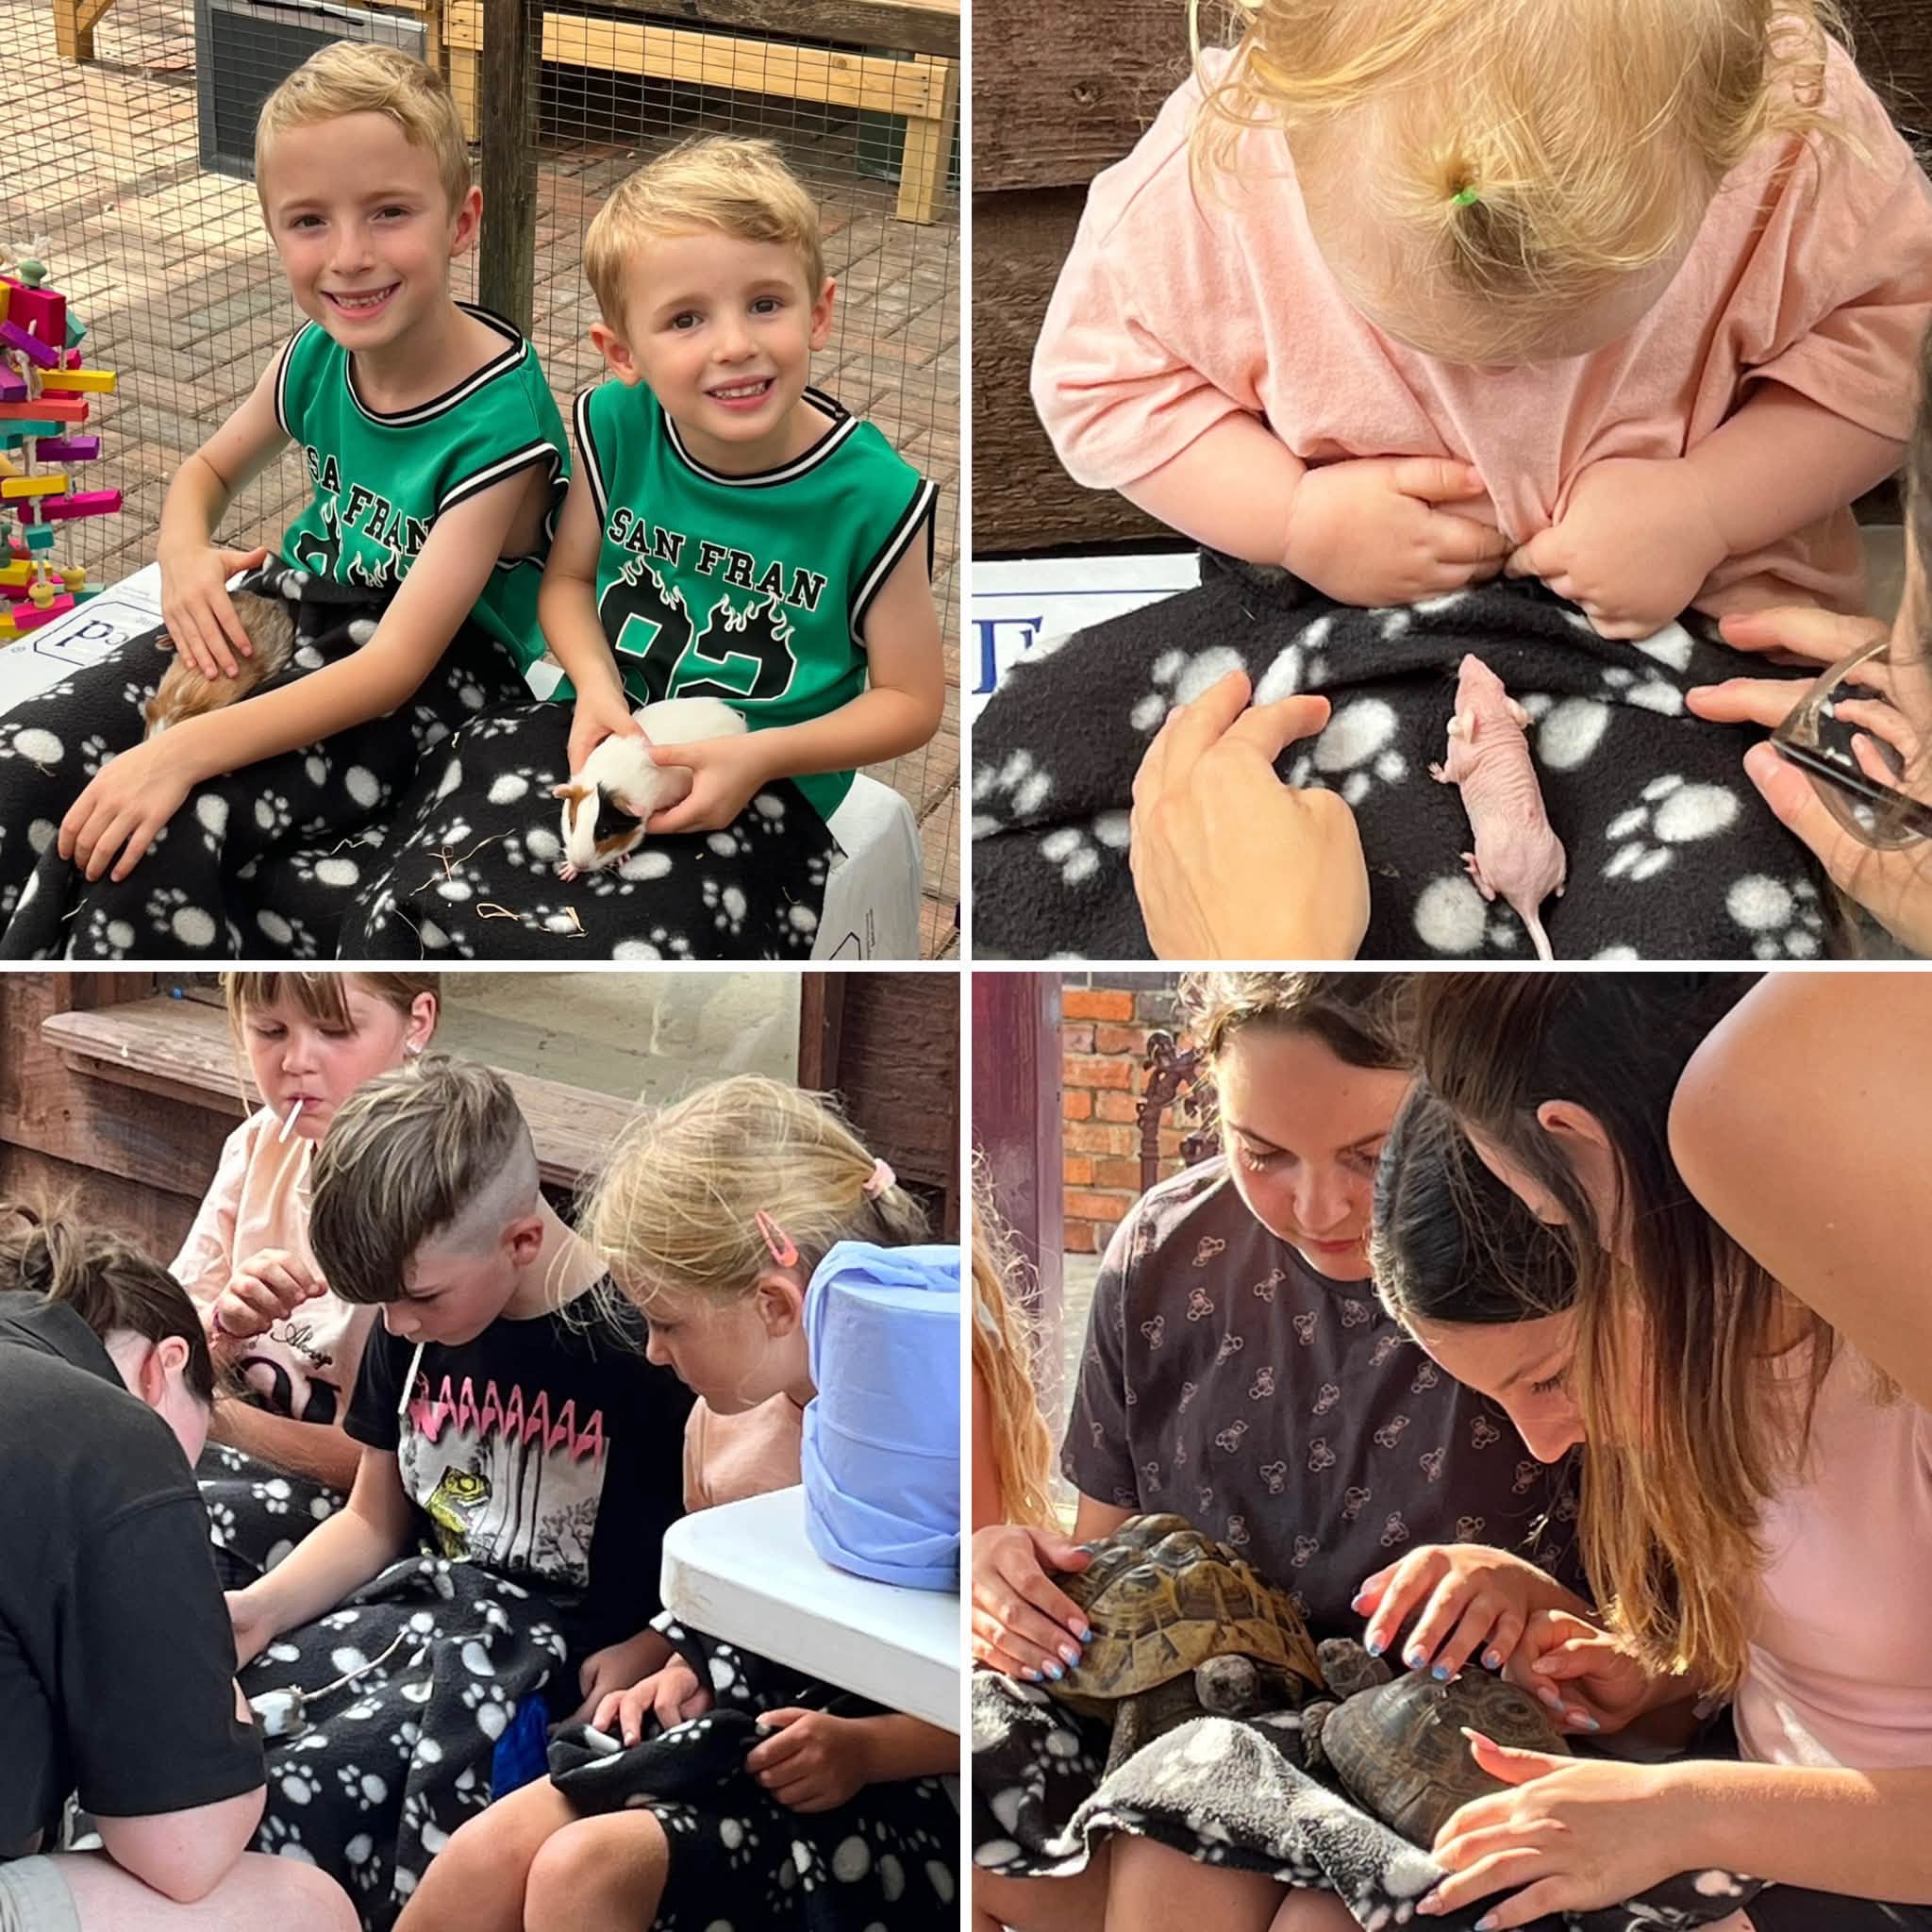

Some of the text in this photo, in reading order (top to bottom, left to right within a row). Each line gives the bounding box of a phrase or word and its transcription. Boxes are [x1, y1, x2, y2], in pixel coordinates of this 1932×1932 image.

[306, 445, 341, 497] SA
[341, 483, 436, 557] FRAN
[608, 507, 827, 612] SAN FRAN
